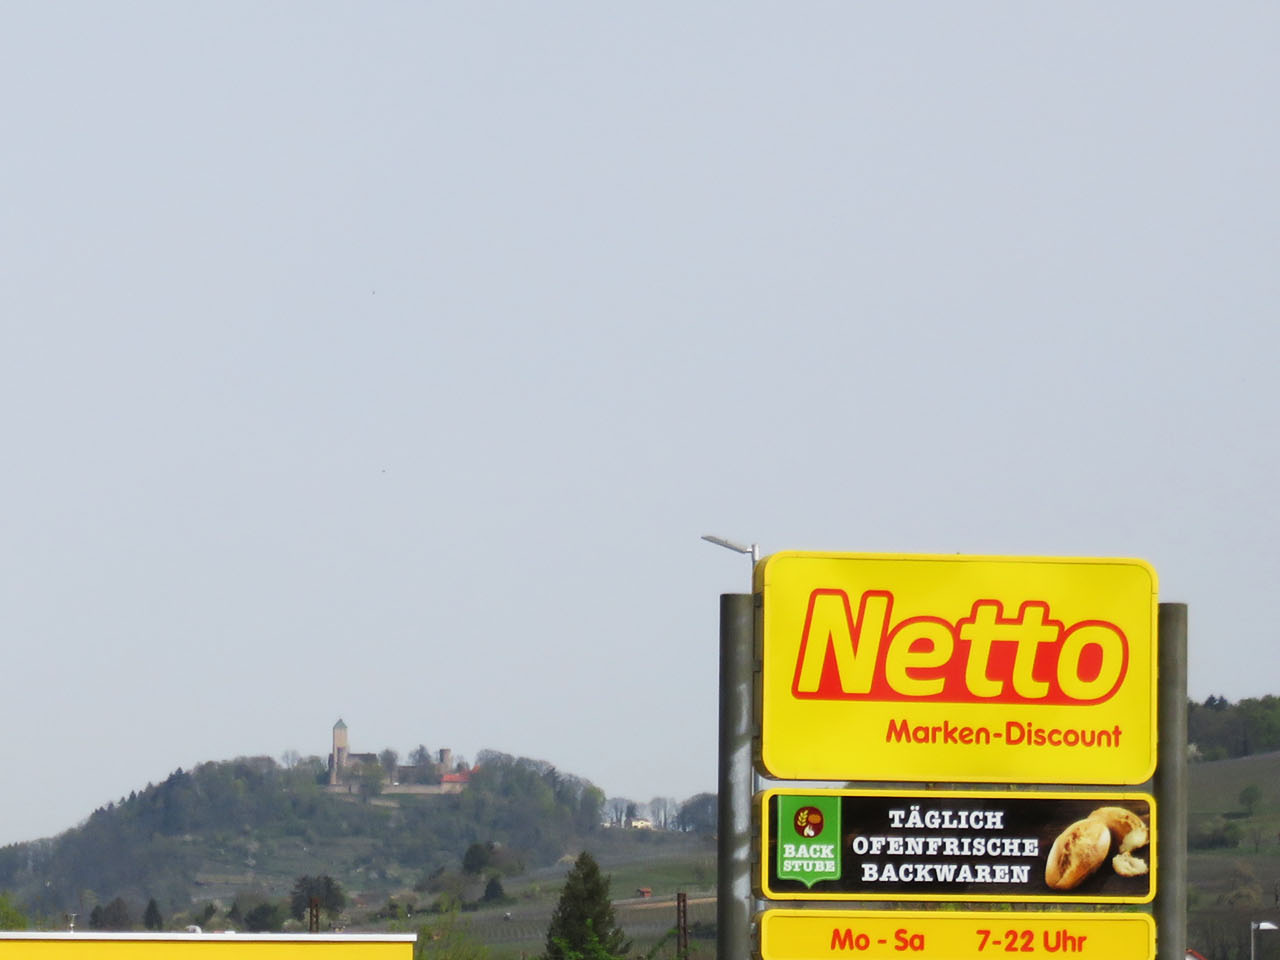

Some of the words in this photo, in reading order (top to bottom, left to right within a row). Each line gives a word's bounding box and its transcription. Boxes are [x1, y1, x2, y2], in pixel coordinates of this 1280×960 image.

[792, 588, 1130, 706] Netto
[885, 719, 1123, 748] Marken-Discount
[888, 806, 1004, 830] TÄGLICH
[783, 844, 835, 858] BACK
[852, 836, 1039, 857] OFENFRISCHE
[783, 860, 836, 873] STUBE
[861, 863, 1031, 883] BACKWAREN
[830, 928, 870, 951] Mo
[894, 928, 926, 951] Sa
[1043, 929, 1089, 953] Uhr
